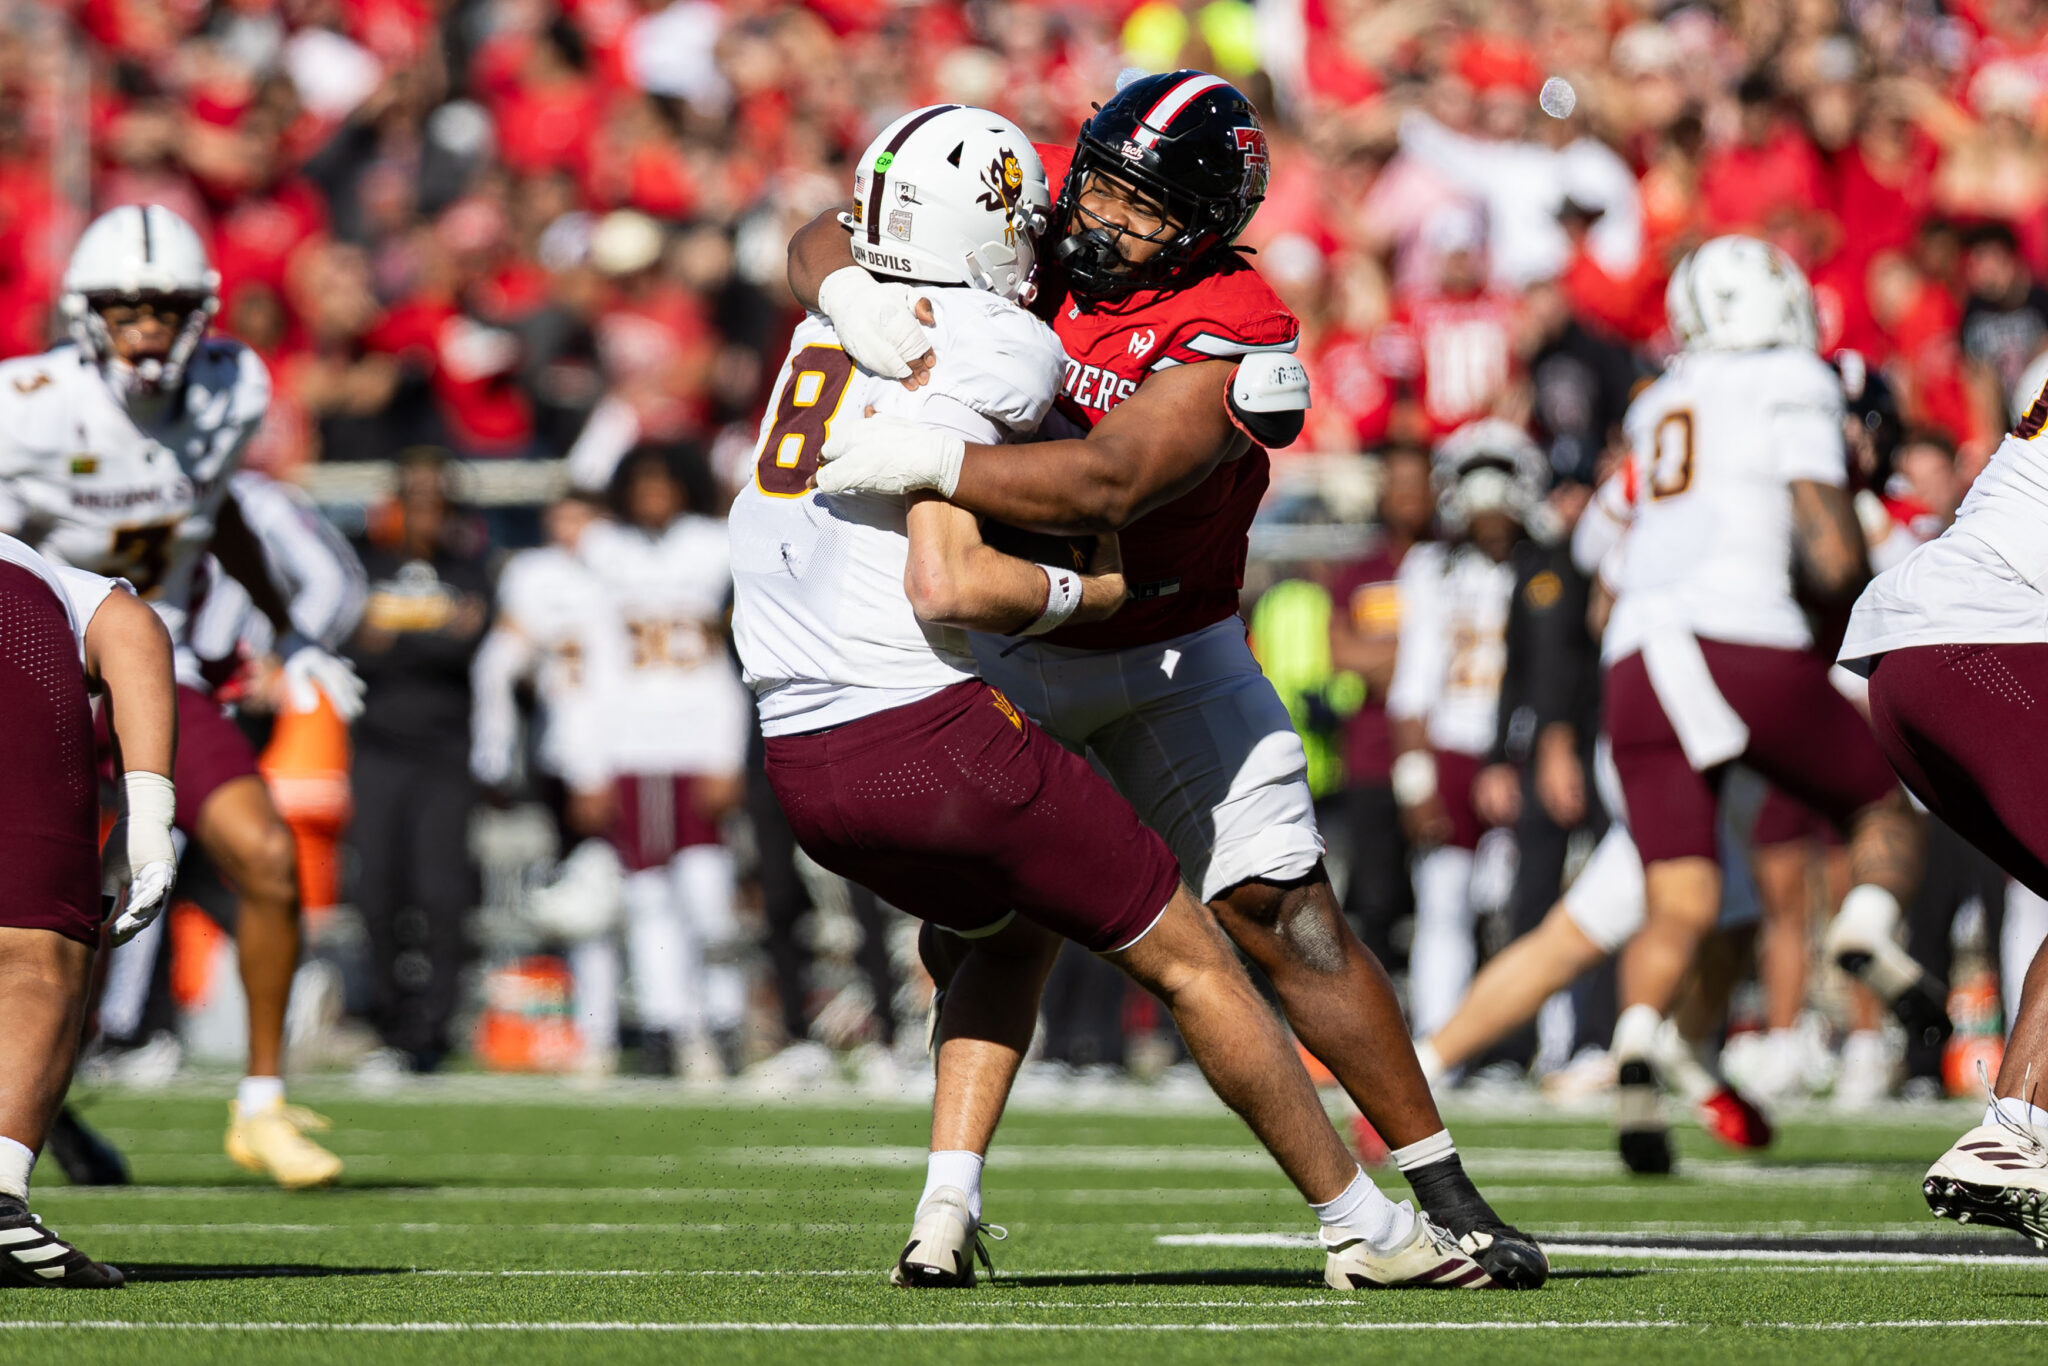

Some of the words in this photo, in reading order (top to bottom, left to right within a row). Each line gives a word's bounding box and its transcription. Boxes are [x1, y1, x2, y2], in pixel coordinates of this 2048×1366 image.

[1121, 141, 1144, 160] Tech
[877, 157, 892, 167] C2P
[867, 250, 912, 273] DEVILS
[755, 342, 856, 499] 8
